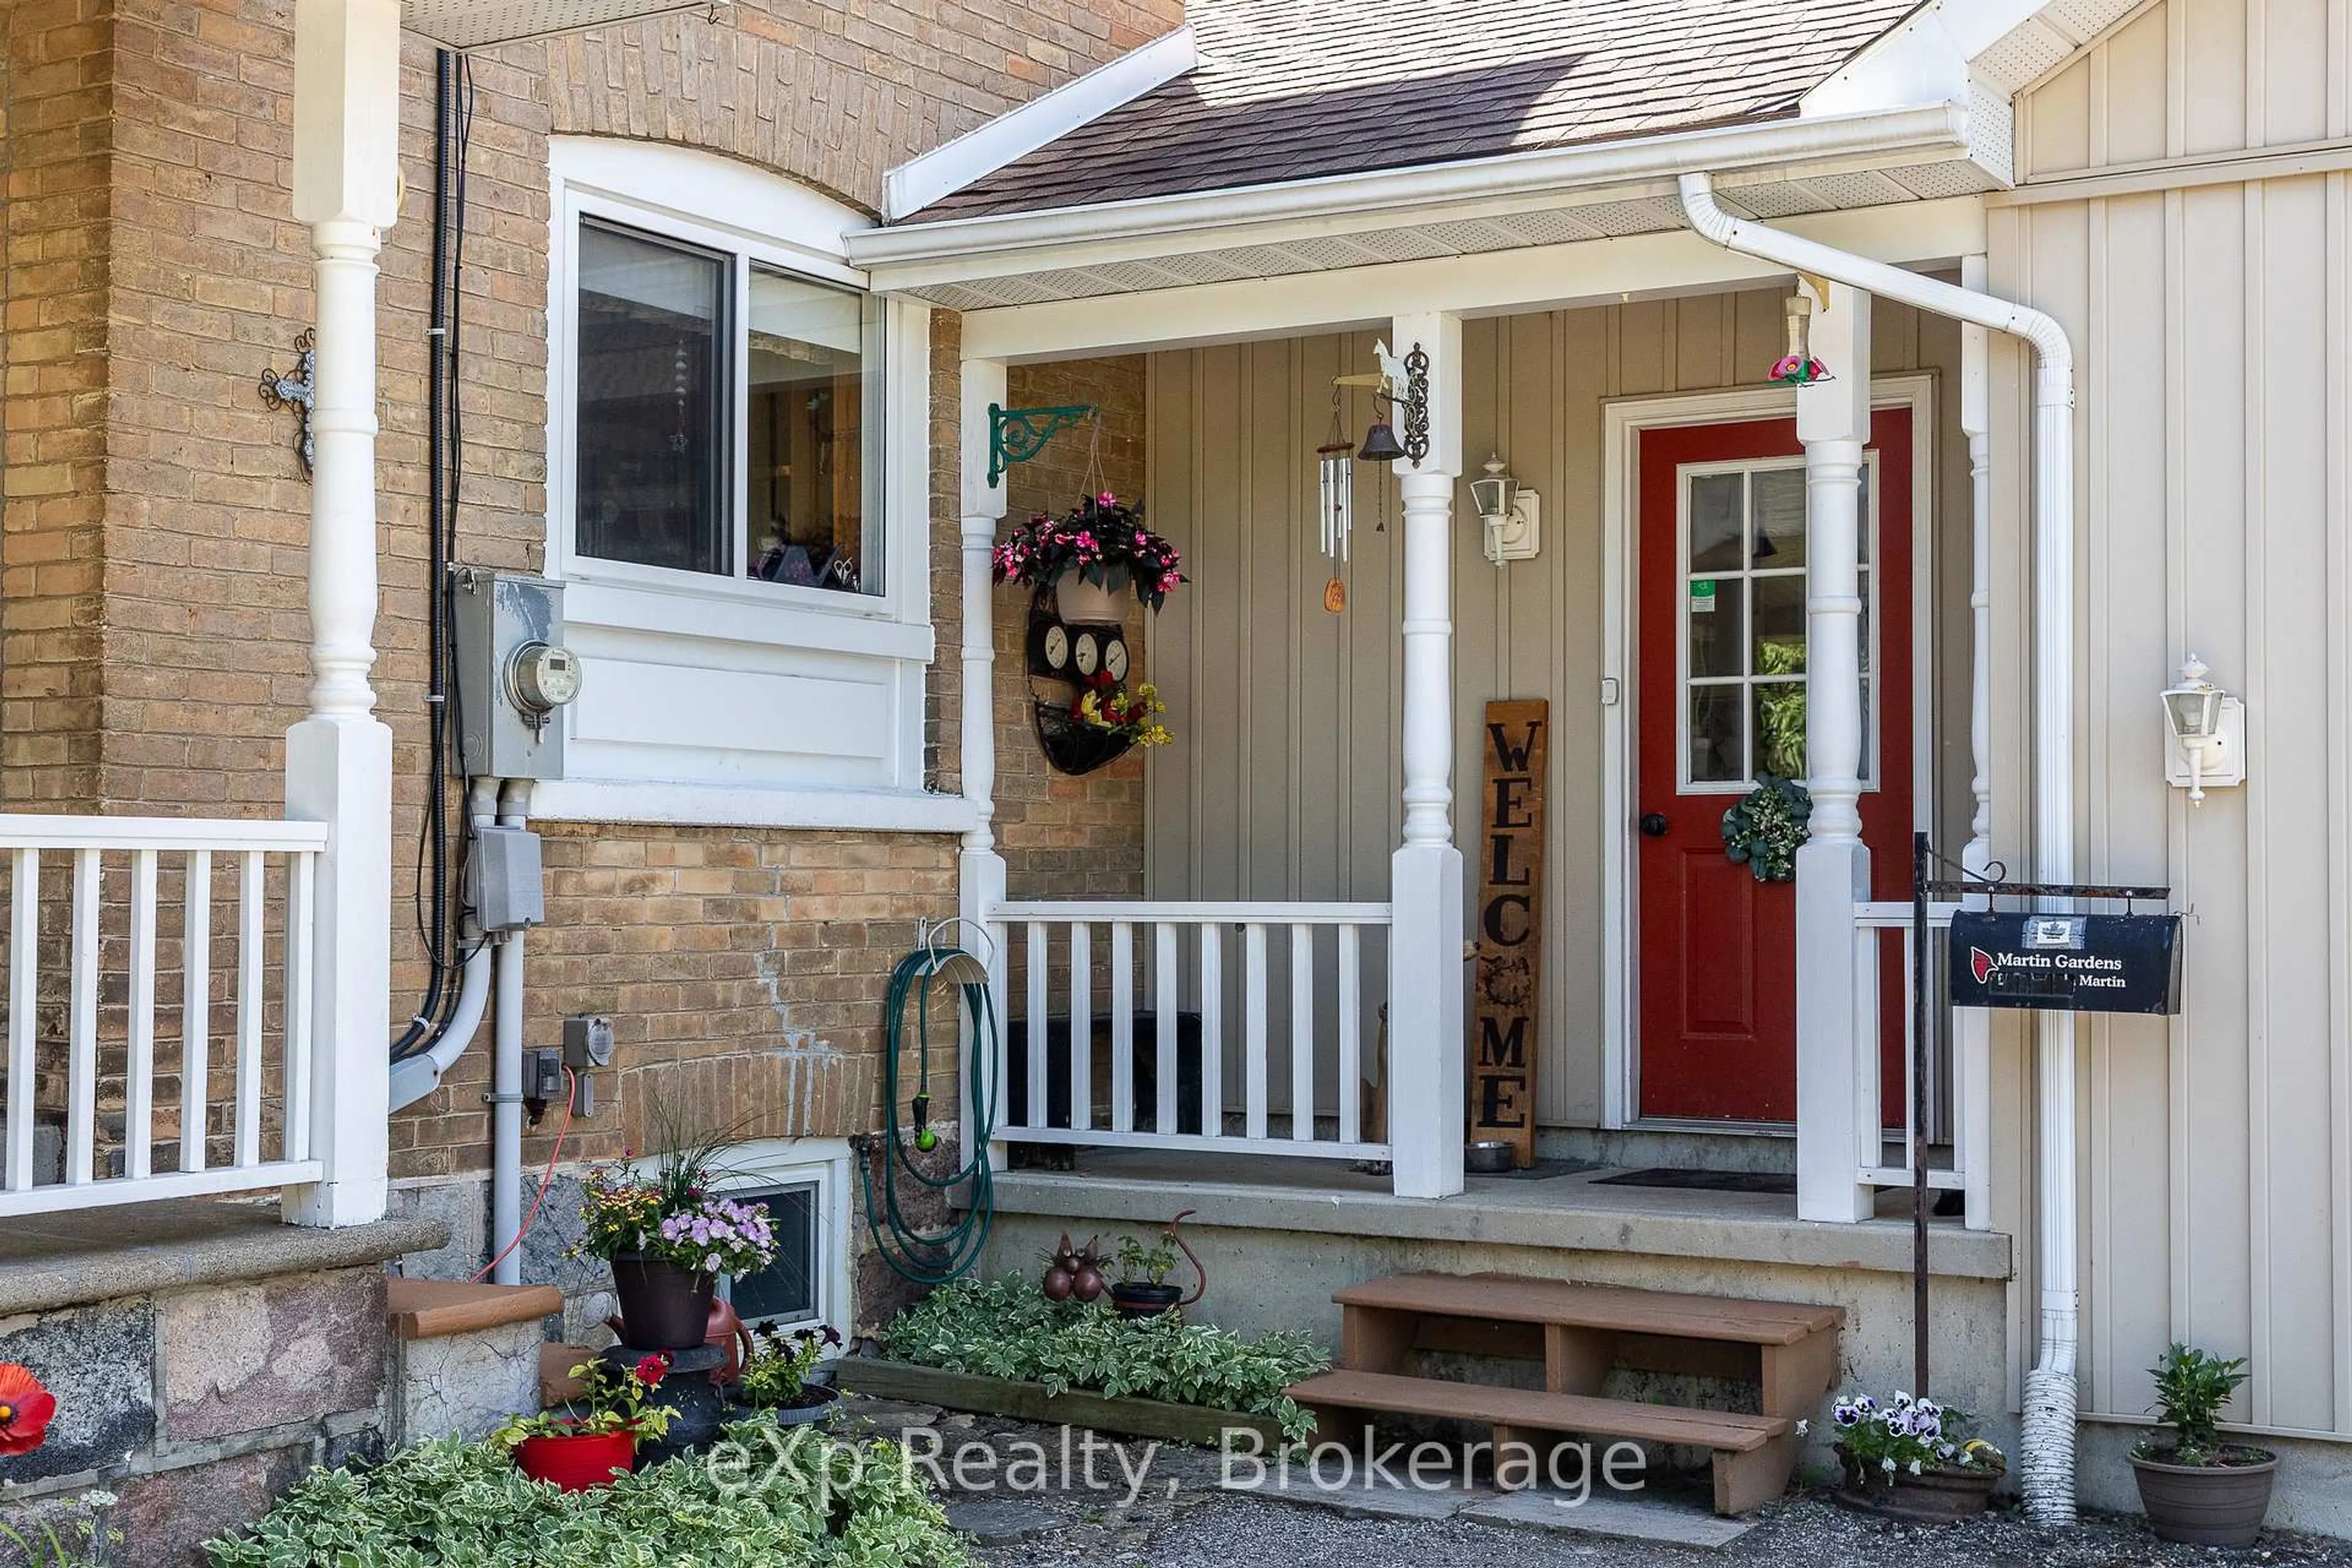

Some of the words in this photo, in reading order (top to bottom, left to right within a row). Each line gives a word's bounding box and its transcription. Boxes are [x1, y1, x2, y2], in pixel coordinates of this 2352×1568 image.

[1997, 952, 2051, 968] Martin
[2055, 954, 2122, 970] Gardens
[2079, 974, 2127, 988] Martin
